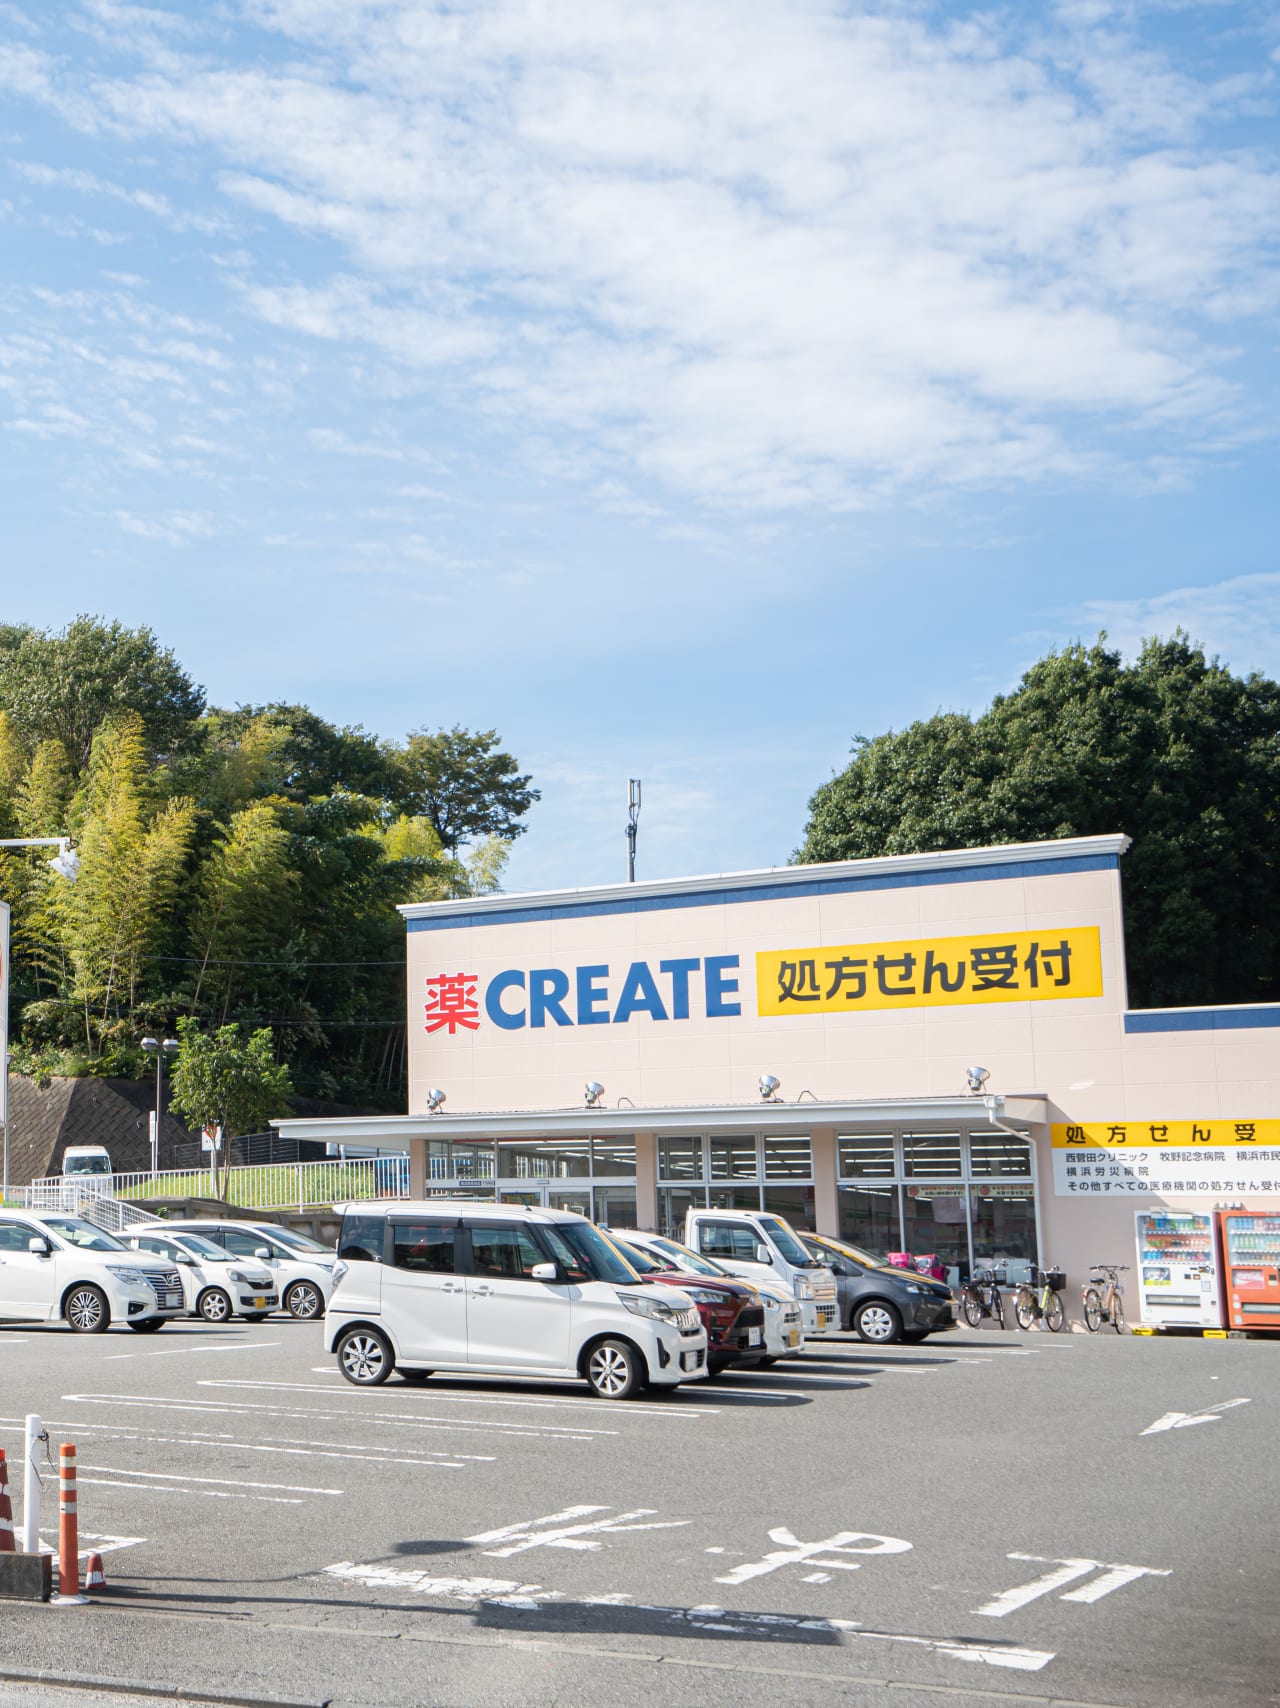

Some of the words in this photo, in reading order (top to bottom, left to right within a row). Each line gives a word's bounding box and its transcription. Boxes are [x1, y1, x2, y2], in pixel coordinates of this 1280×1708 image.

[777, 940, 1073, 1003] 処方せん受付
[424, 972, 480, 1034] 薬
[485, 954, 742, 1030] CREATE
[1066, 1166, 1150, 1177] 横浜労災病院
[1160, 1151, 1226, 1162] 牧野記念病院
